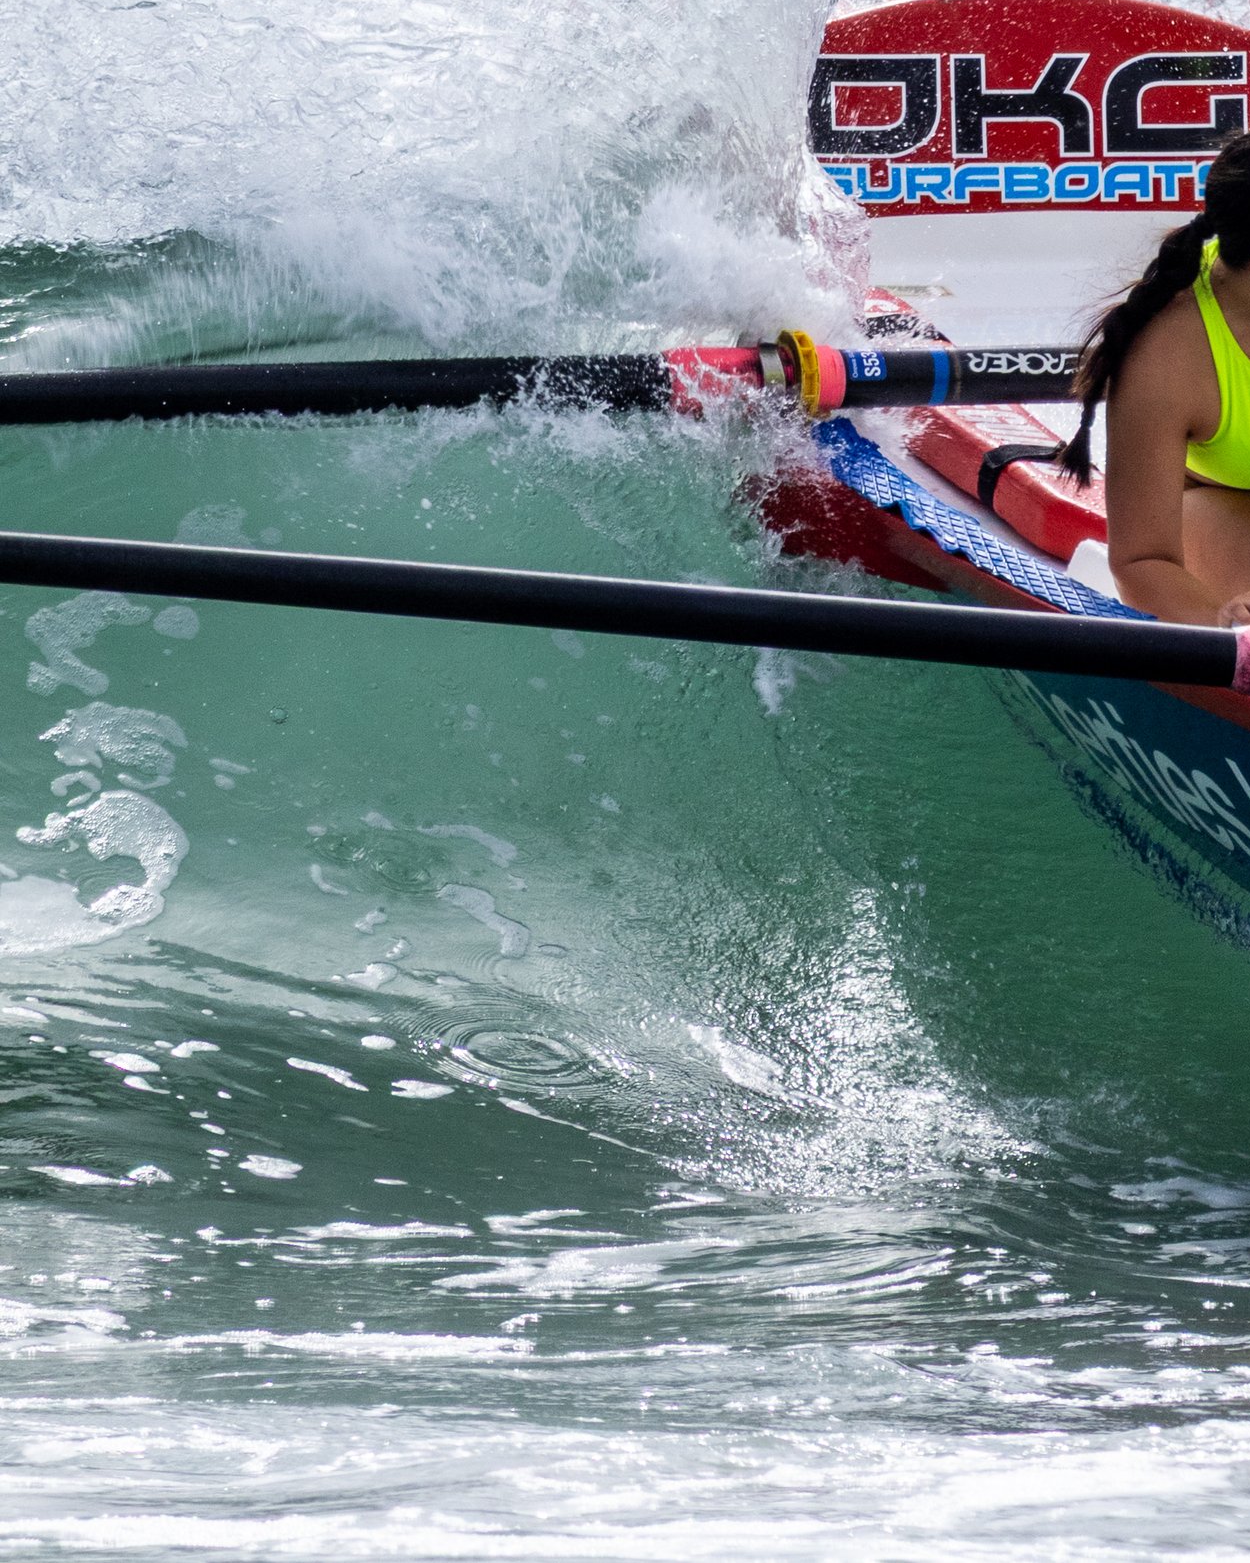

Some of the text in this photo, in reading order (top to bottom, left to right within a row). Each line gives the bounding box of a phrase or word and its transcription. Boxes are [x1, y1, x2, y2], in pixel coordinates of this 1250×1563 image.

[809, 53, 1248, 159] DKG
[823, 162, 1207, 204] SURFBOAT
[860, 350, 882, 377] S53
